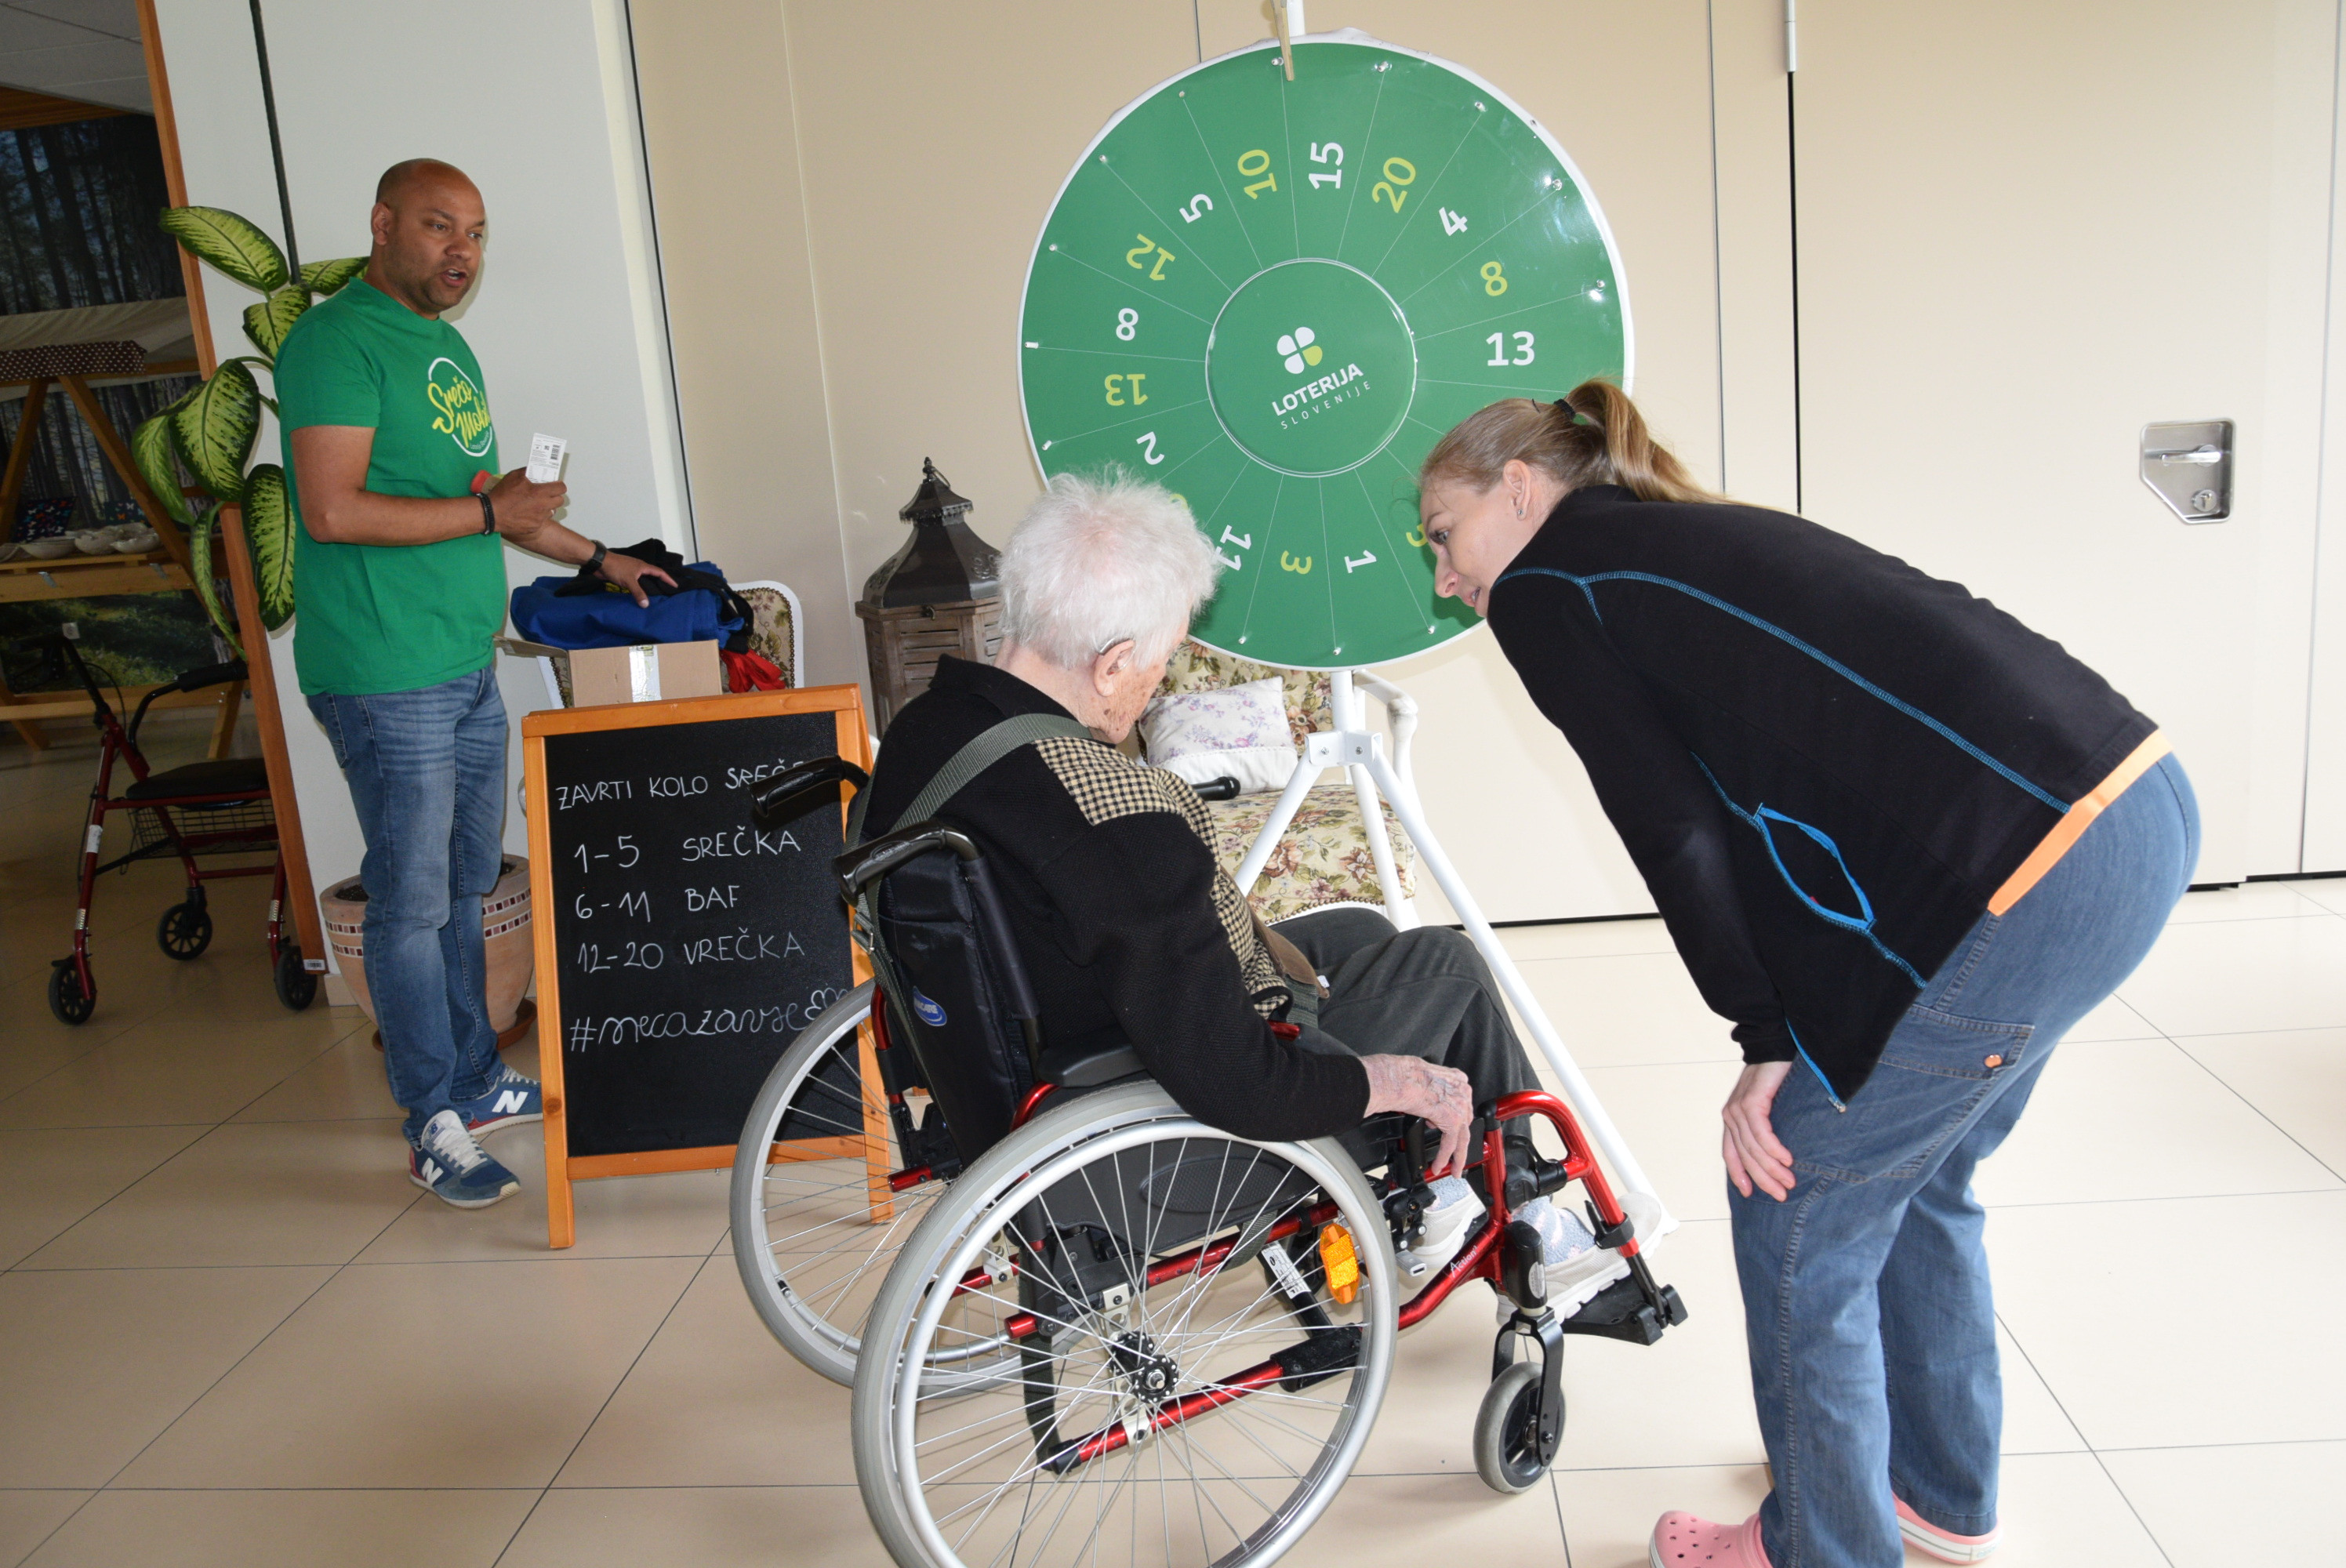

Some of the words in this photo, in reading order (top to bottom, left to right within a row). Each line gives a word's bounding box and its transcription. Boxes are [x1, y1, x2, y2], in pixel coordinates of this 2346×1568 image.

[1237, 149, 1276, 199] 10
[1309, 142, 1343, 189] 15
[1371, 157, 1416, 213] 20
[1179, 194, 1213, 223] 5
[1439, 206, 1468, 236] 4
[1126, 233, 1175, 281] 12
[1480, 260, 1507, 296] 8
[1115, 308, 1138, 340] 8
[1486, 330, 1534, 366] 13
[1104, 373, 1147, 405] 13
[1272, 363, 1364, 416] LOTERIJA
[1280, 381, 1371, 429] SLOVENIJE
[1136, 431, 1164, 466] 2
[1215, 524, 1251, 571] 11
[1280, 550, 1312, 575] 3
[1345, 550, 1376, 573] 1
[555, 780, 632, 811] ZAVRTI
[648, 775, 708, 798] KOLO
[724, 757, 804, 789] SREČ
[574, 835, 640, 873] 1-5
[681, 825, 801, 862] SREČKA
[685, 884, 740, 912] BAF
[577, 942, 663, 974] 12-20
[683, 927, 805, 965] VREČKA
